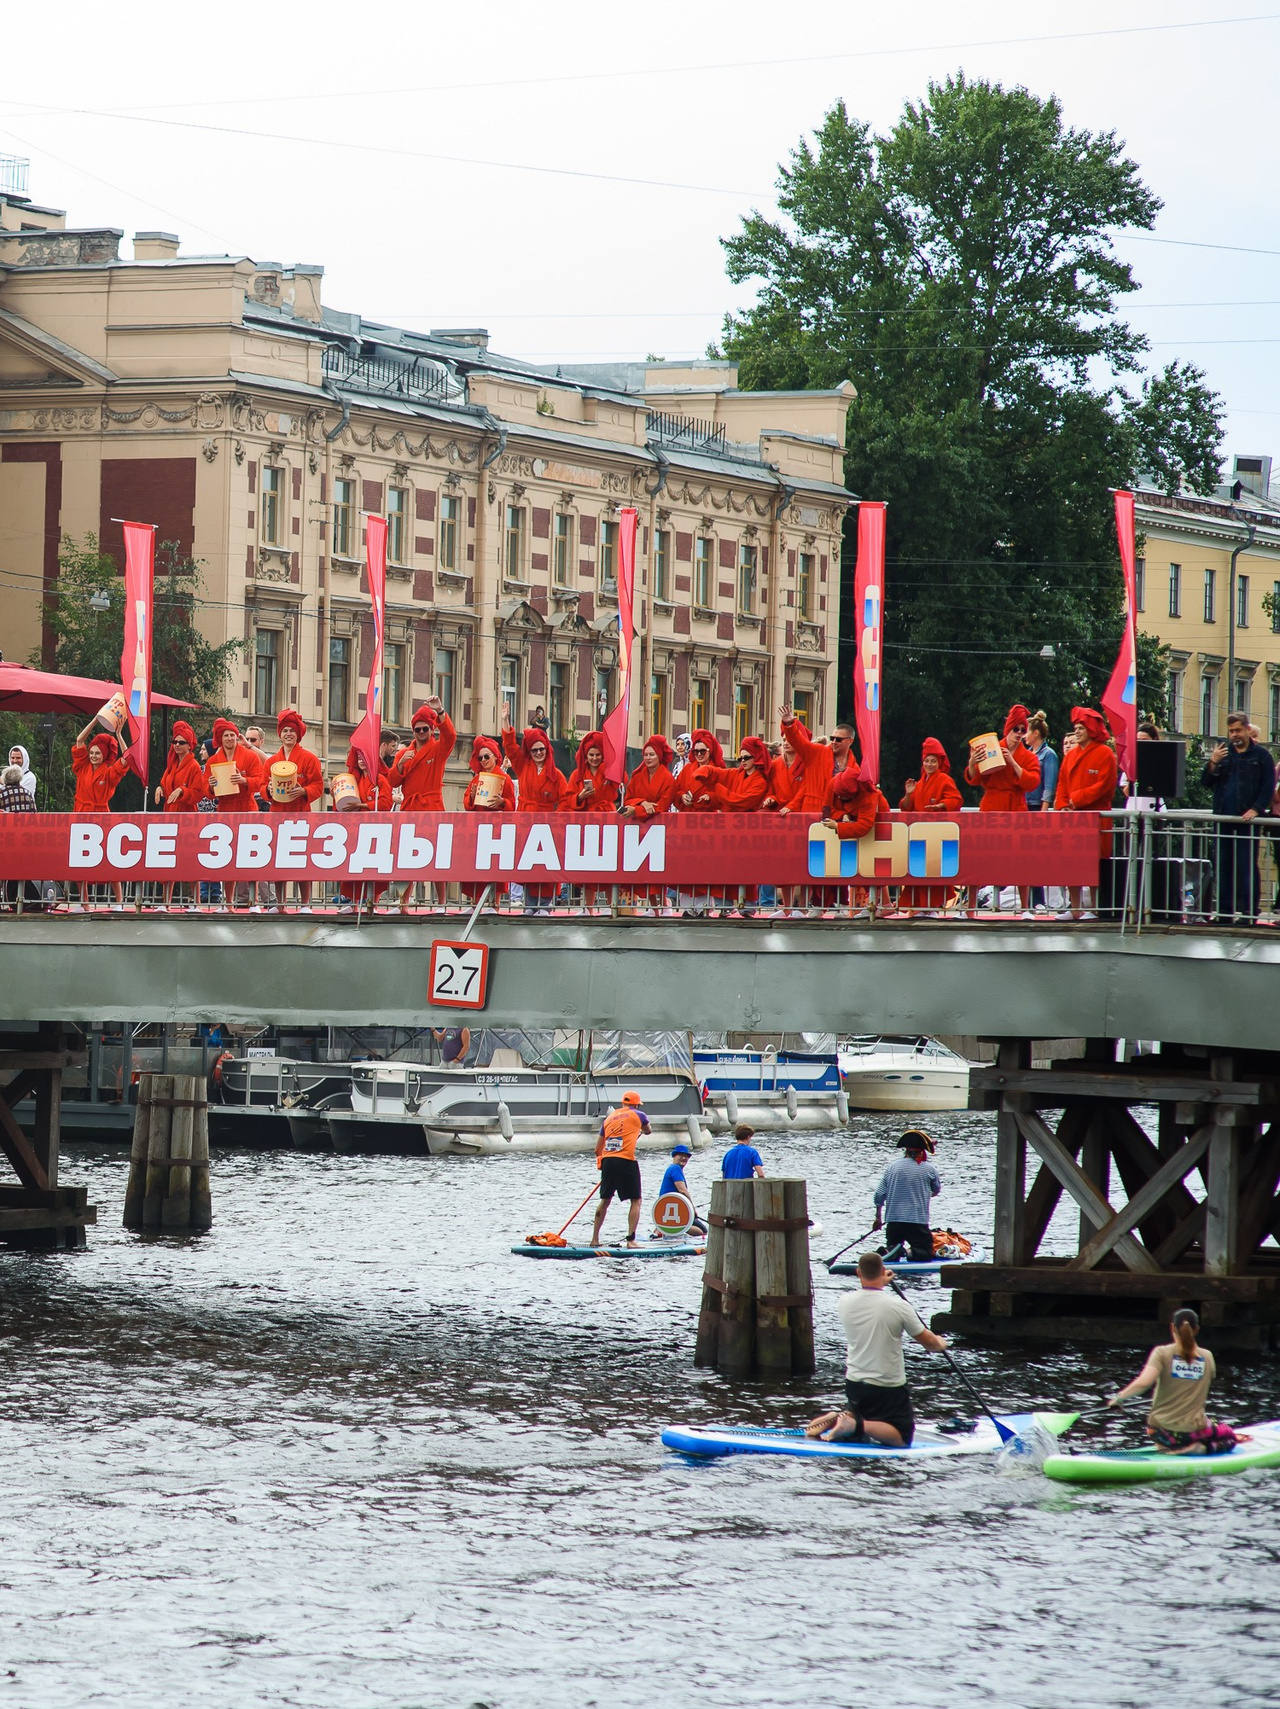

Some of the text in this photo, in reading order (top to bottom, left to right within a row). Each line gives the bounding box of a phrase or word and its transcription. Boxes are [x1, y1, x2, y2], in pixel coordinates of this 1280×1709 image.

[68, 819, 666, 874] ВСЕ ЗВЁЗДЫ НАШИ
[808, 822, 960, 878] ТНТ
[436, 964, 479, 996] 2.7
[662, 1203, 680, 1223] Д
